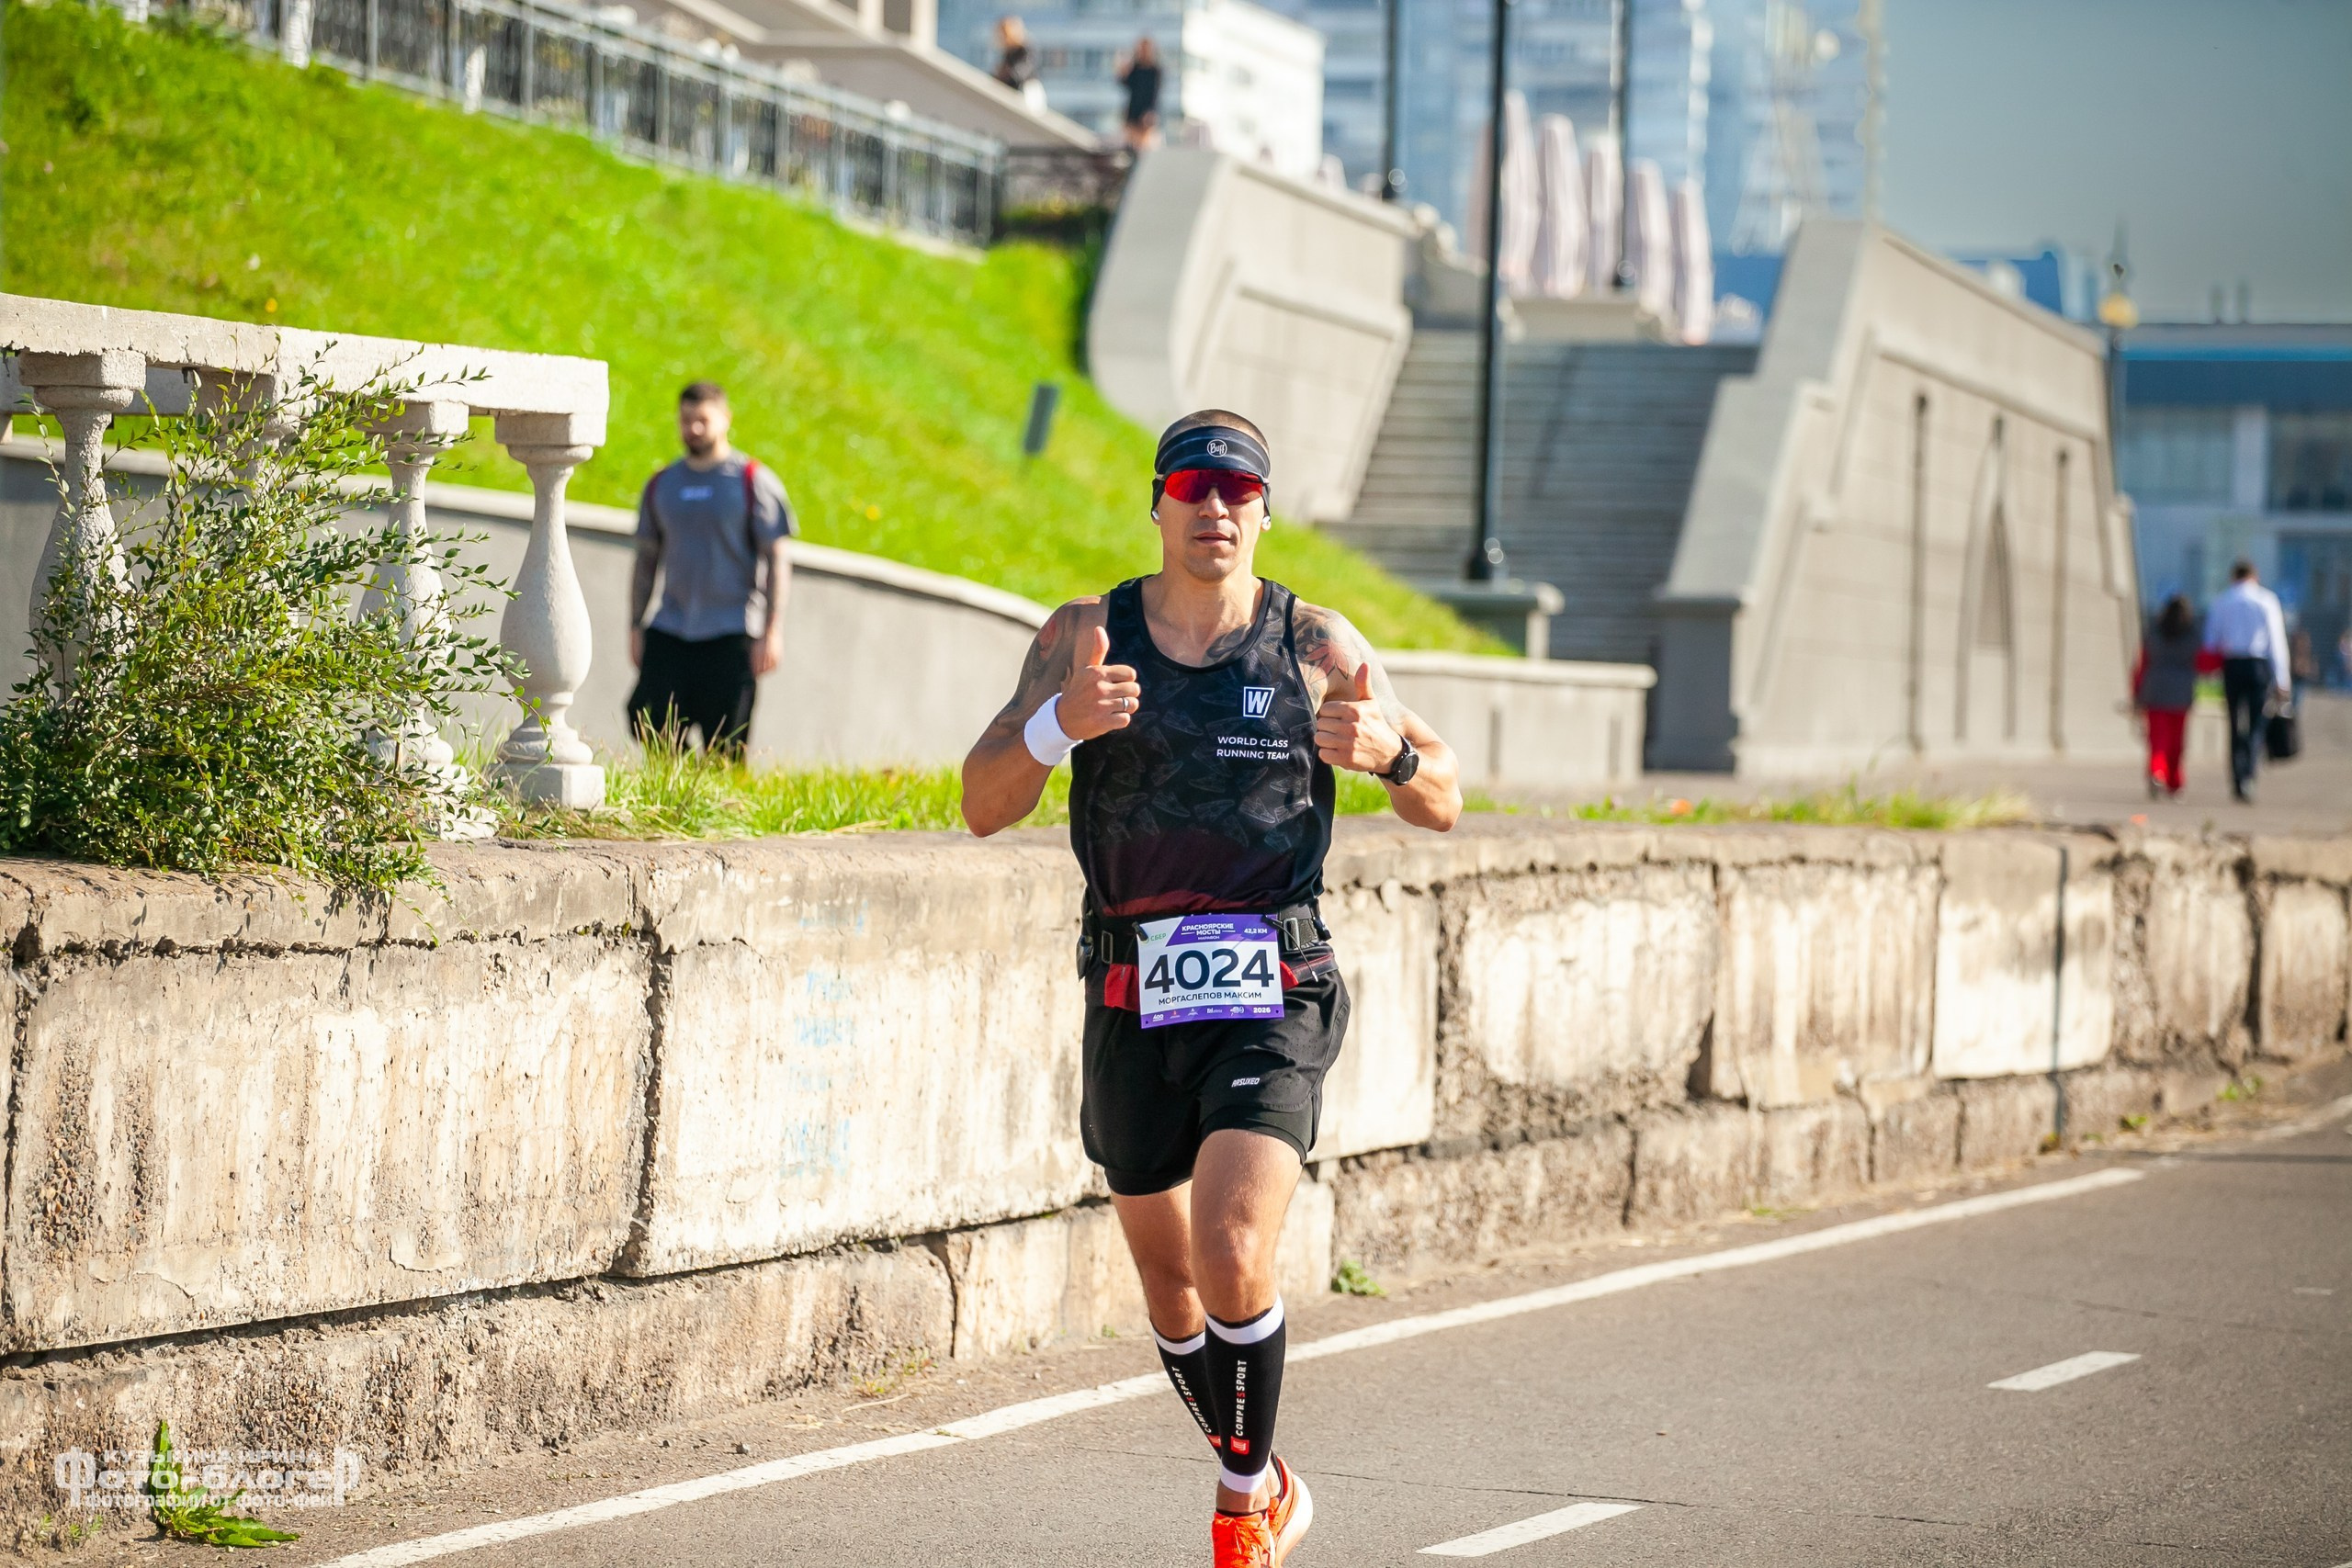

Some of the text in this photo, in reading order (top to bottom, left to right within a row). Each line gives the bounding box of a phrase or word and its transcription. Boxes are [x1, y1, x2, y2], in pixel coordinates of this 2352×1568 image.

[1210, 442, 1225, 455] Buff
[1248, 691, 1269, 714] W
[1217, 736, 1289, 748] WORLD CLASS
[1216, 749, 1290, 761] RUNNING TEAM
[1182, 923, 1234, 931] КРАСНОЯРСКИЕ
[1150, 932, 1167, 942] СБЕР
[1144, 948, 1274, 994] 4024
[1159, 991, 1261, 1006] МОРГАСЛЕПОВ МАКСИМ
[1231, 1077, 1261, 1088] ARSUXED
[1171, 1366, 1212, 1433] COMPRESSPORT
[1235, 1359, 1248, 1437] COMPRESSPORT
